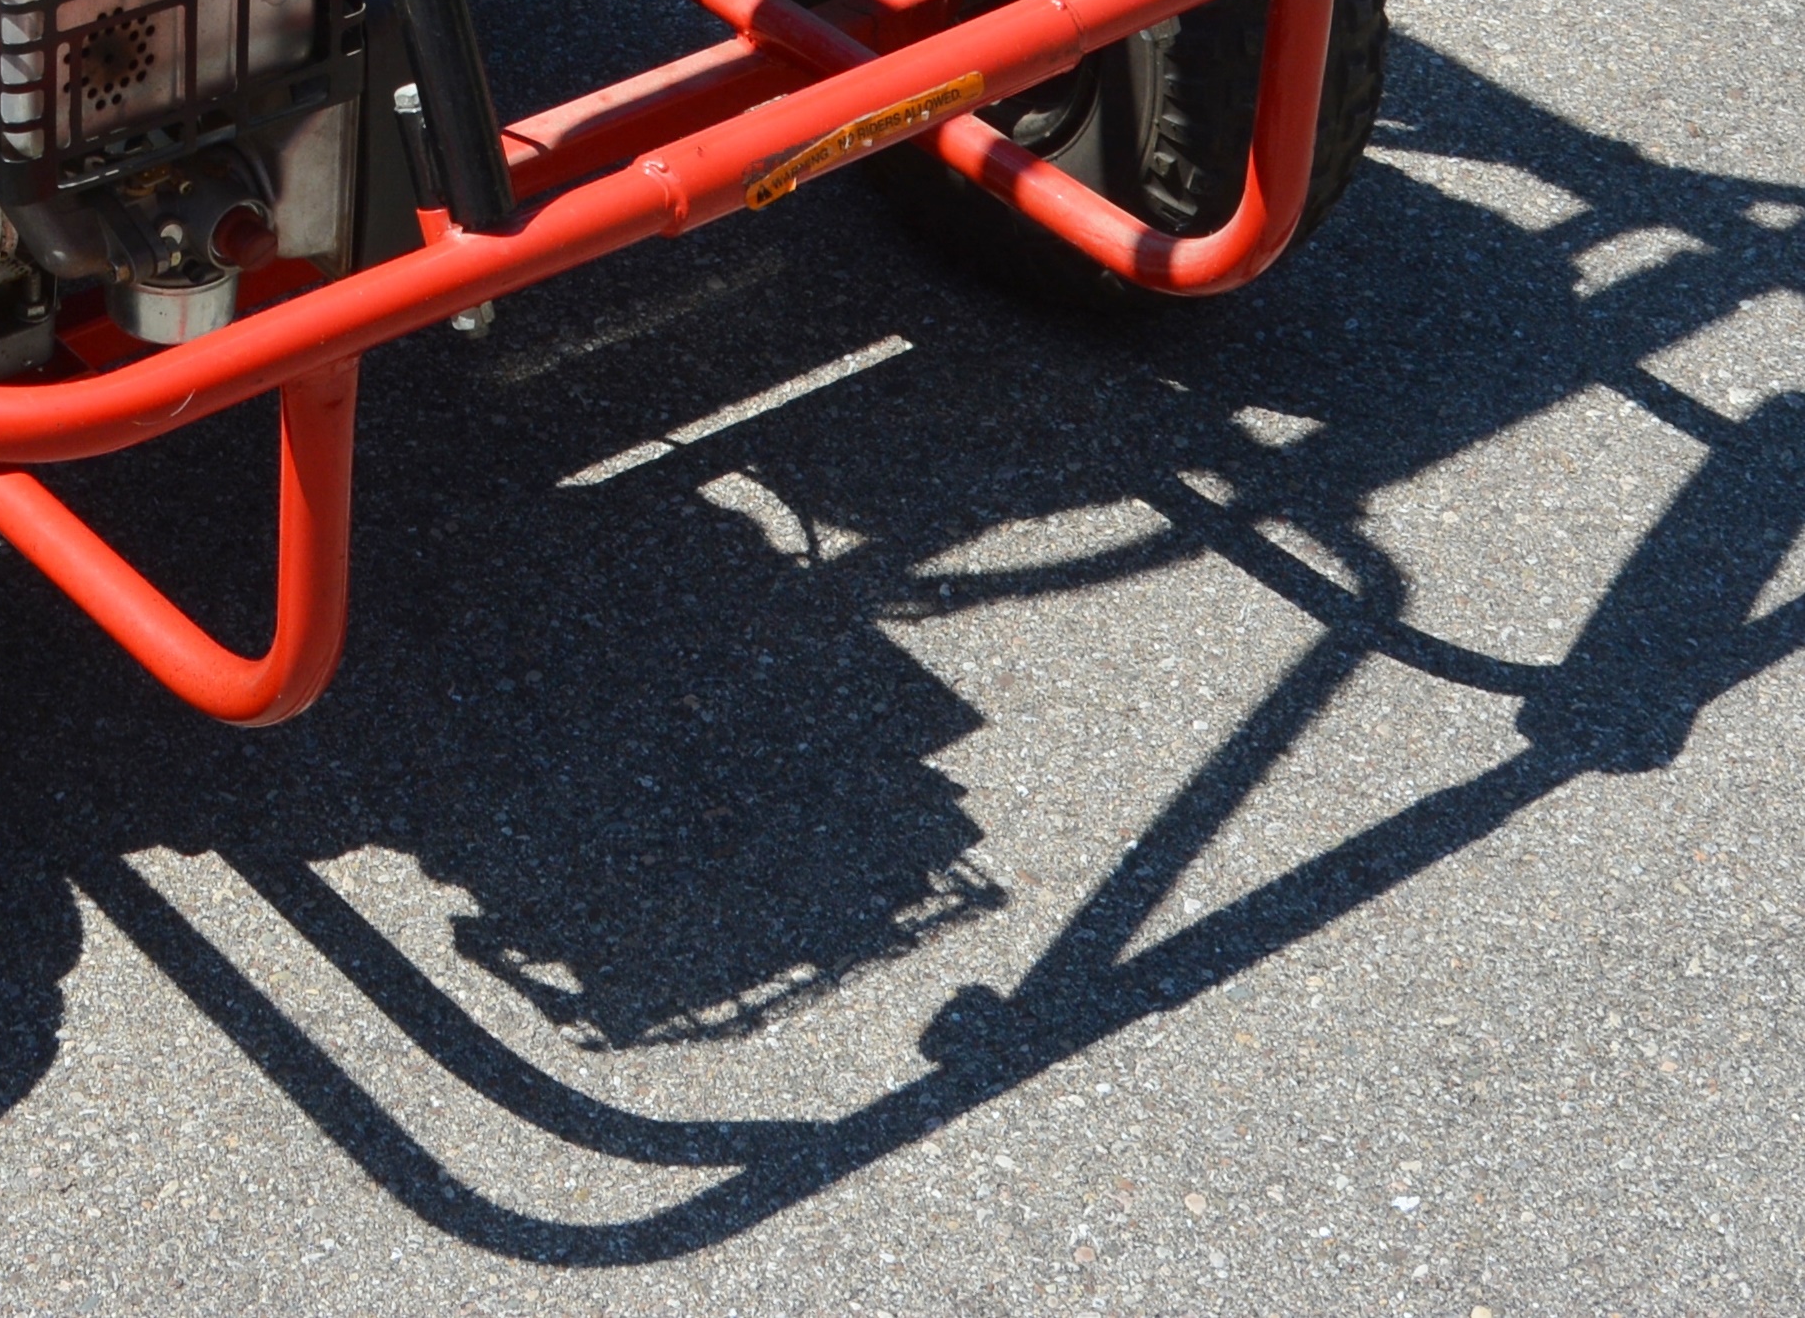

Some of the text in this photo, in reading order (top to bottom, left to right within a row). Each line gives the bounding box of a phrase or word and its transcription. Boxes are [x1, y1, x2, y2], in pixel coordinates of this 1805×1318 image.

[837, 131, 856, 151] NO
[857, 112, 902, 141] RIDERS
[904, 89, 963, 121] ALLOWED.
